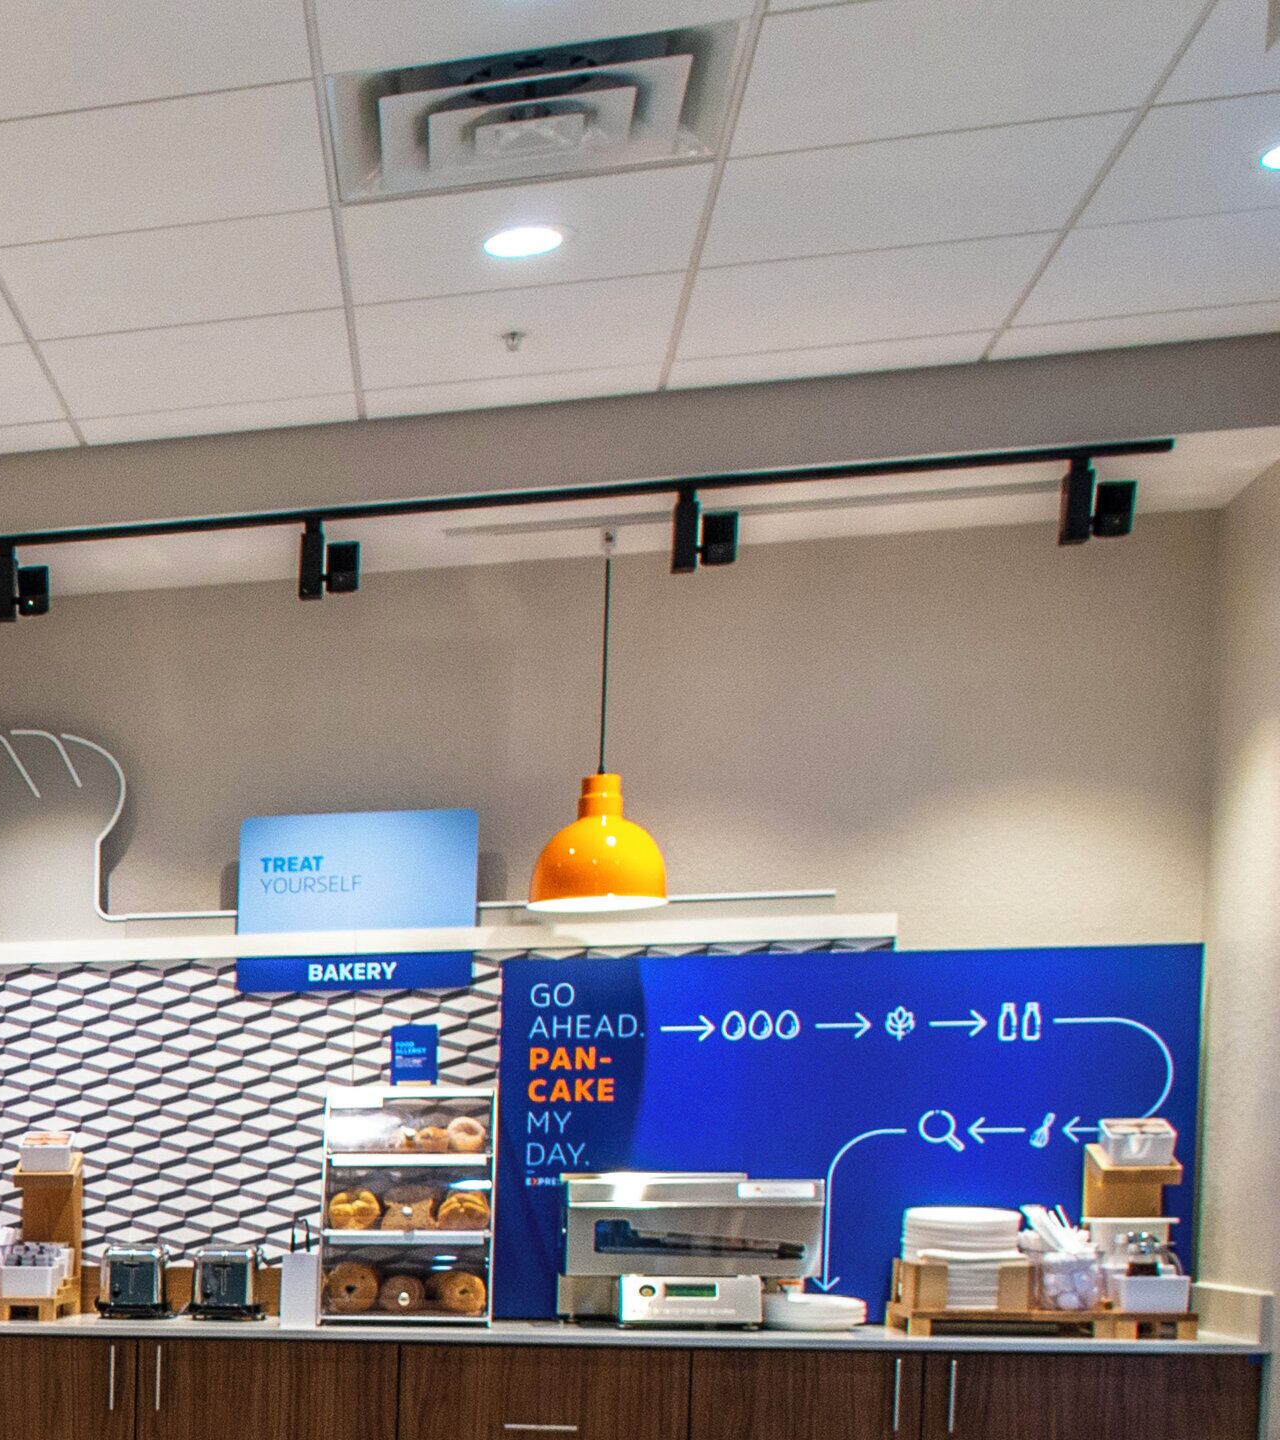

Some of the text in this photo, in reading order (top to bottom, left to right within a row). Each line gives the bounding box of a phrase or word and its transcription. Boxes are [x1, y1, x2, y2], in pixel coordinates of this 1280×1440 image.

[261, 856, 324, 873] TREAT
[260, 875, 362, 894] YOURSELF
[308, 961, 397, 981] BAKERY
[530, 982, 575, 1008] GO
[529, 1014, 644, 1039] AHEAD.
[529, 1046, 612, 1071] PAN-
[527, 1078, 615, 1102] CAKE
[527, 1110, 572, 1134] MY
[526, 1142, 589, 1166] DAY.
